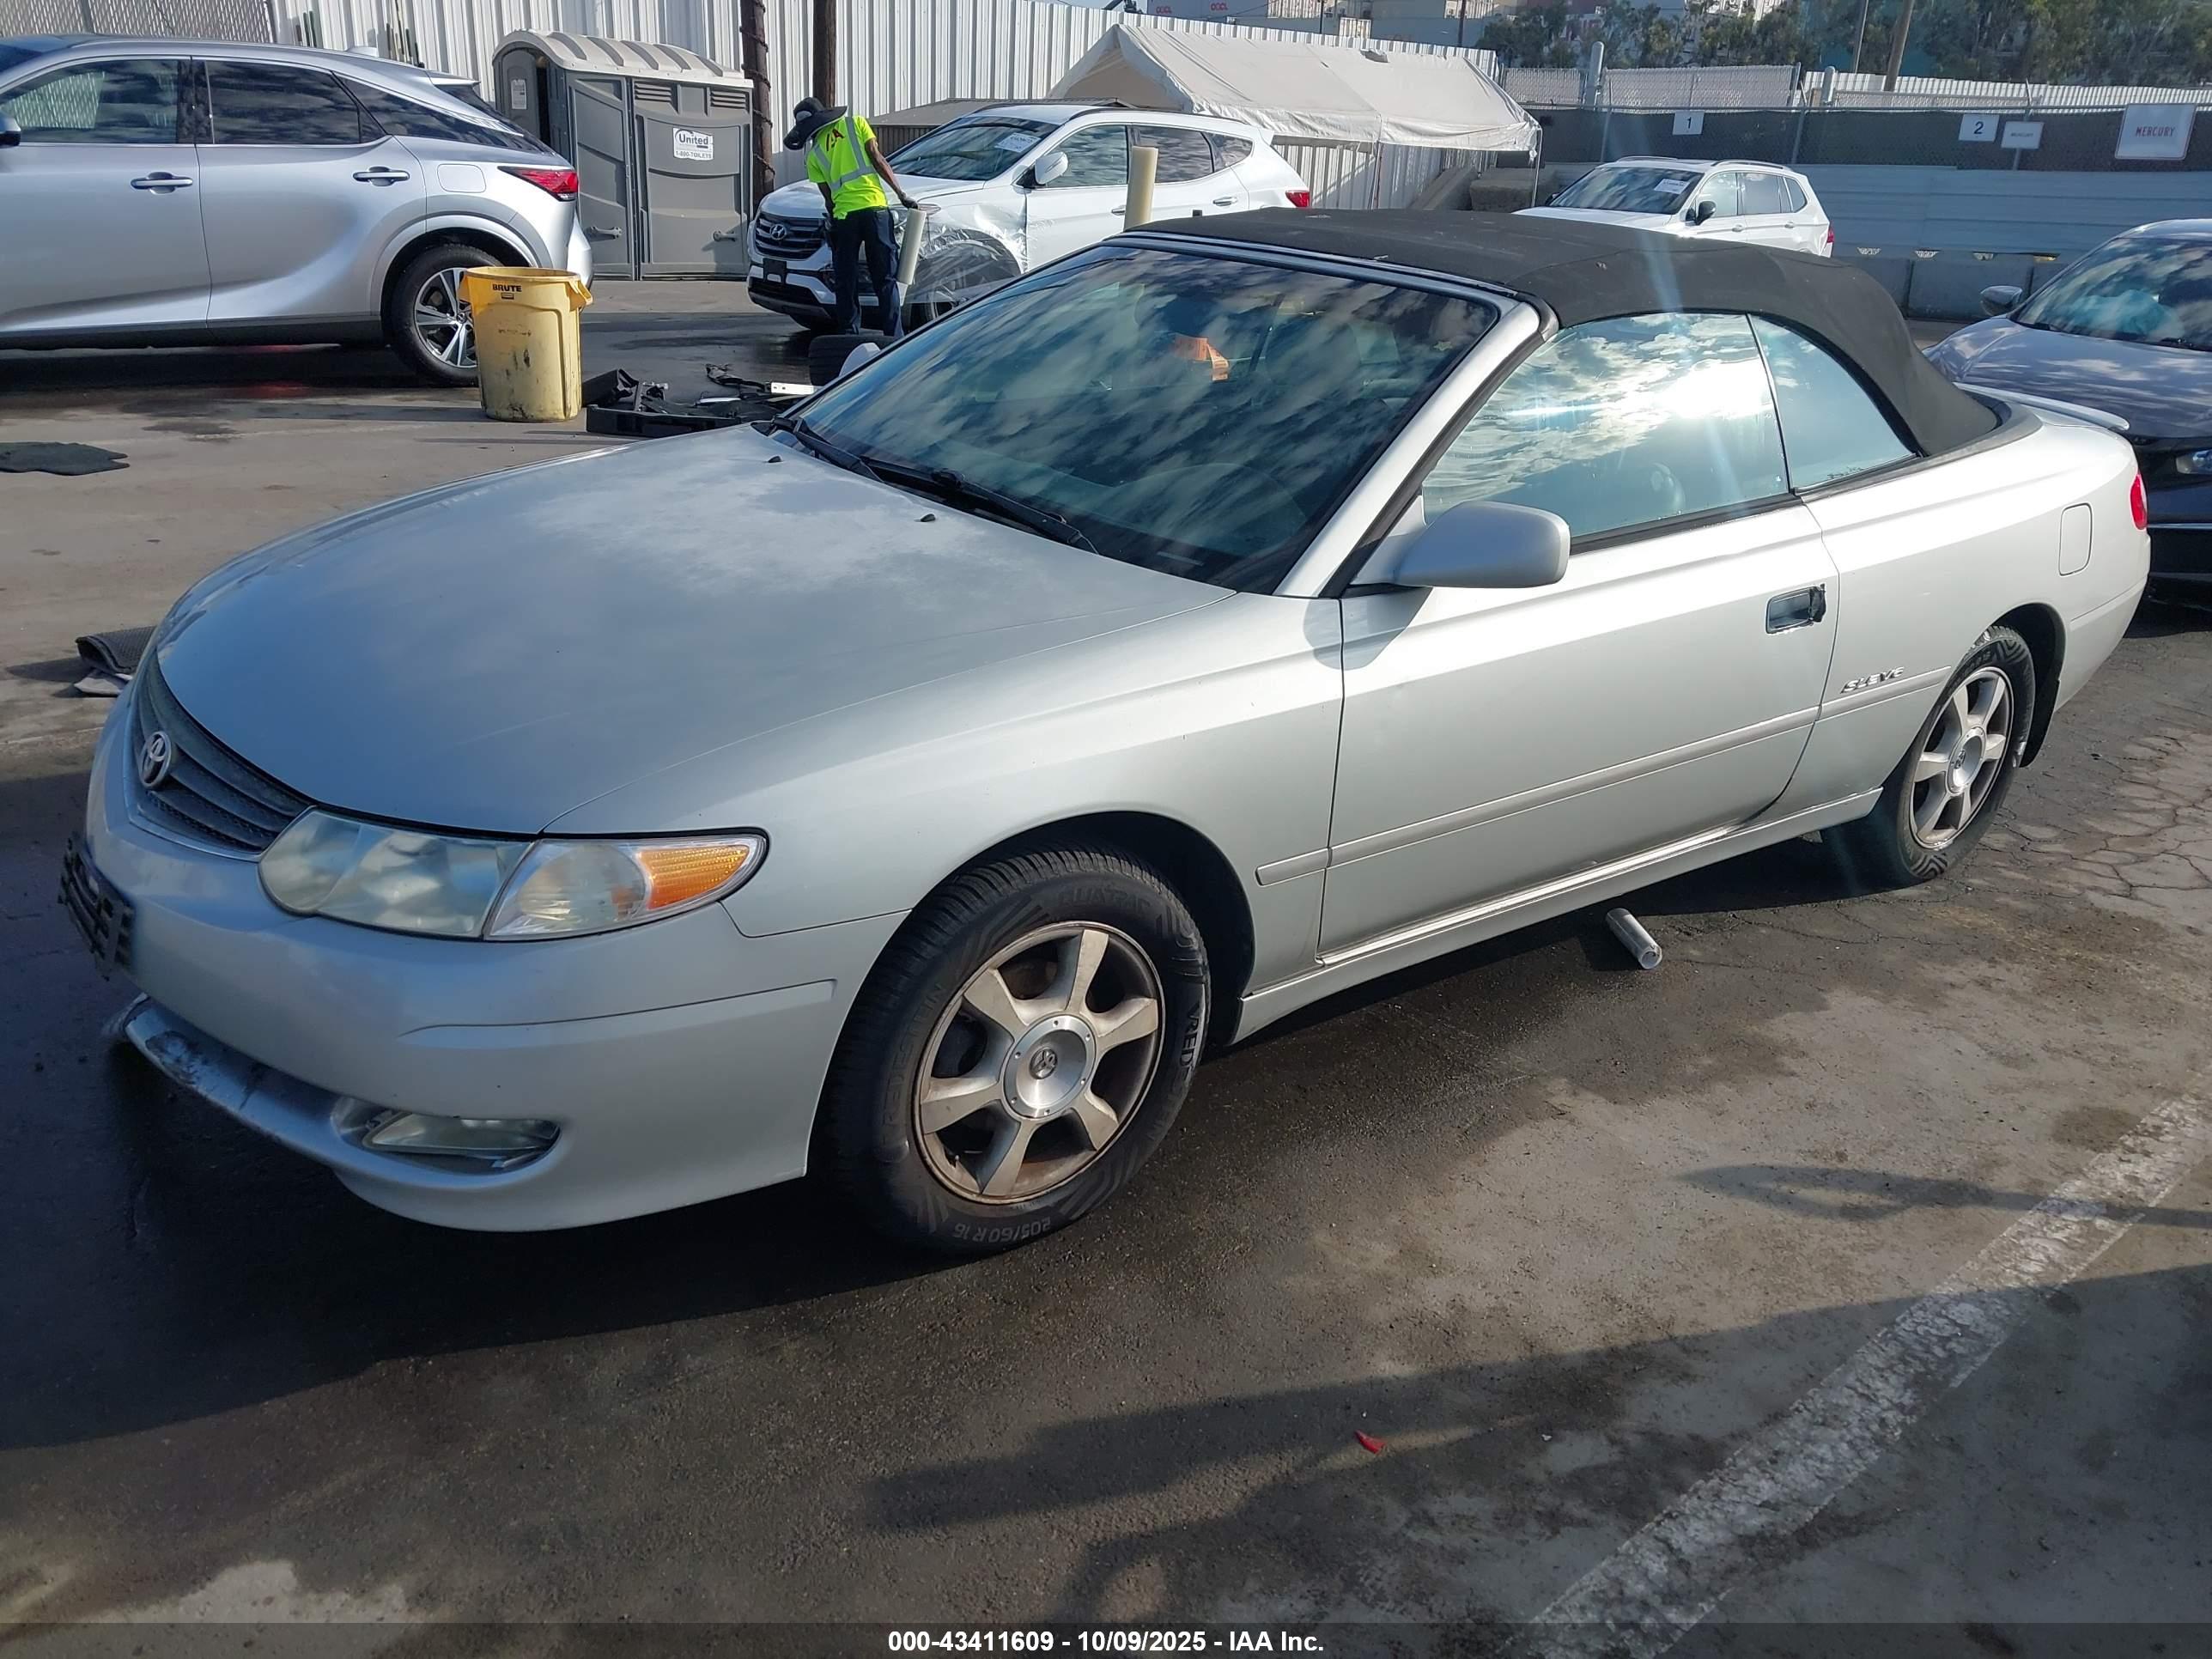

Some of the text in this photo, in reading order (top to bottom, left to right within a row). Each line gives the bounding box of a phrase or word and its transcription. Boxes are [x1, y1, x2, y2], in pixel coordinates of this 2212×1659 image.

[1687, 117, 1692, 129] 1
[1973, 120, 1985, 135] 2
[2135, 126, 2176, 137] MERCURY
[678, 133, 708, 145] United
[492, 283, 522, 292] BRUTE
